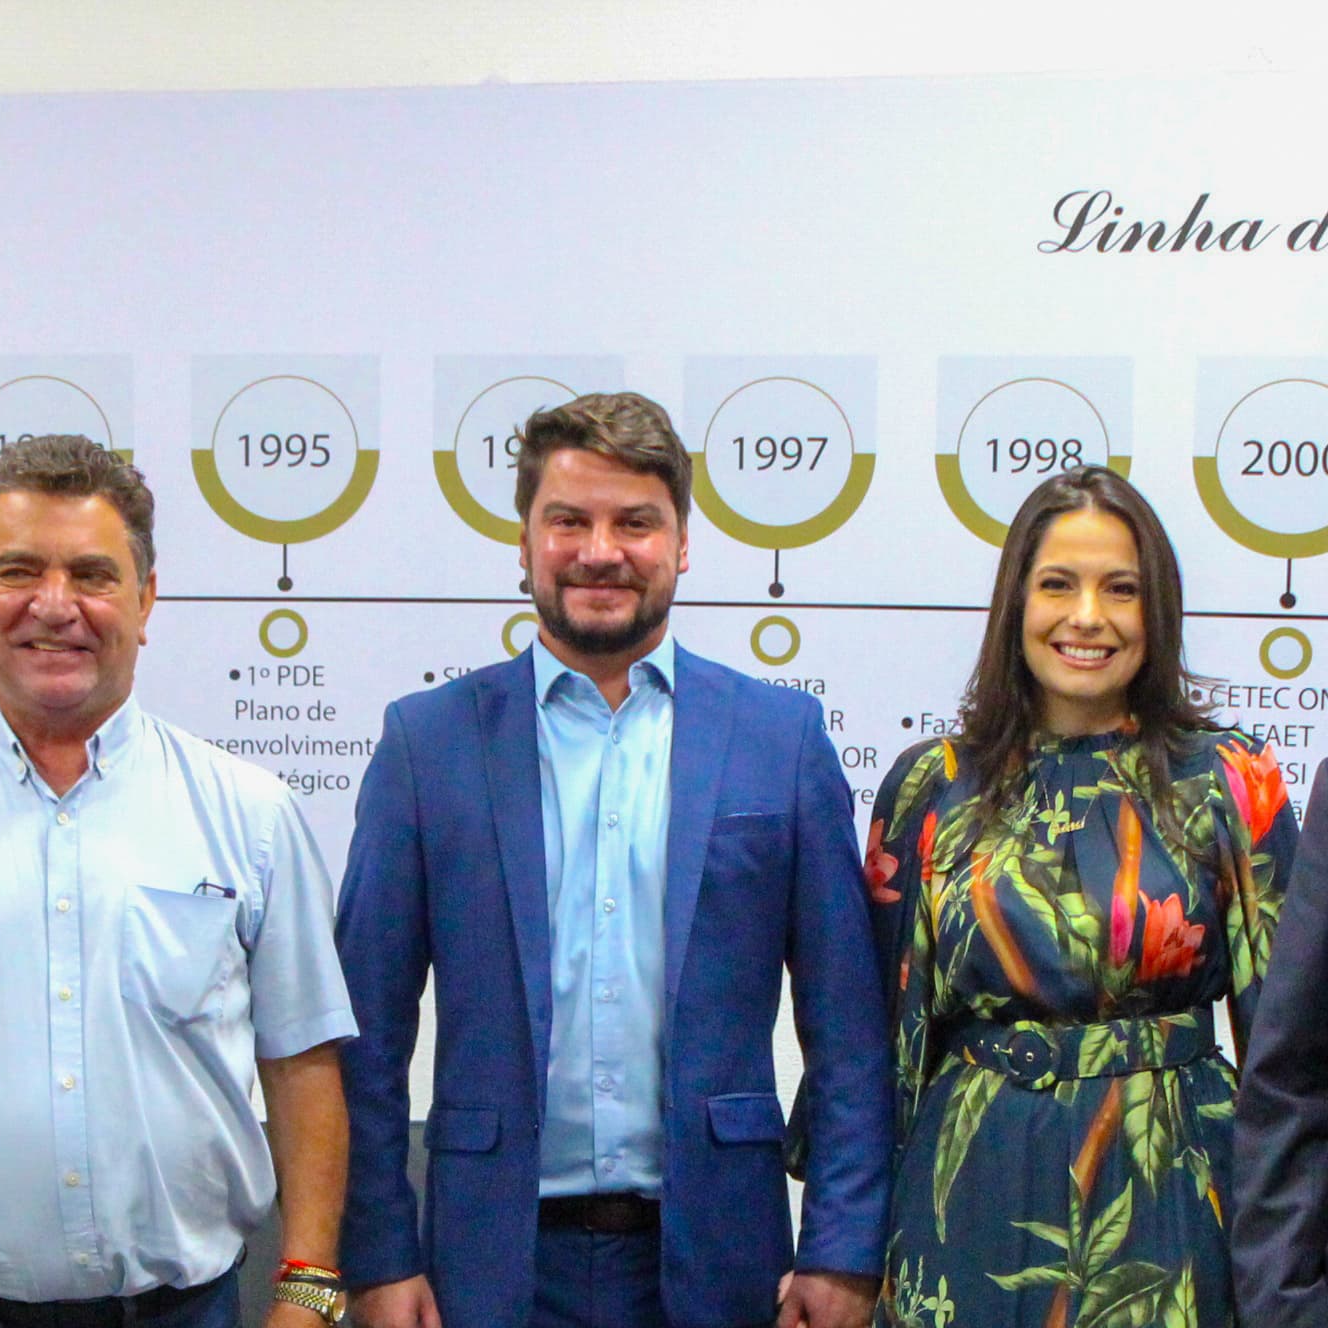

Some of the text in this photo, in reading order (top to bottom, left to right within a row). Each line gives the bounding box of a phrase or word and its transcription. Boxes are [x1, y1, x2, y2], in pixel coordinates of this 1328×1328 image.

[1037, 190, 1280, 254] Linha
[237, 432, 331, 469] 1995
[731, 435, 828, 473] 1997
[985, 437, 1083, 474] 1998
[277, 665, 325, 687] PDE
[235, 699, 336, 721] Plano de
[1209, 685, 1291, 710] CETEC
[921, 712, 960, 735] Faz
[204, 733, 374, 756] senvolviment
[277, 768, 350, 796] tégico
